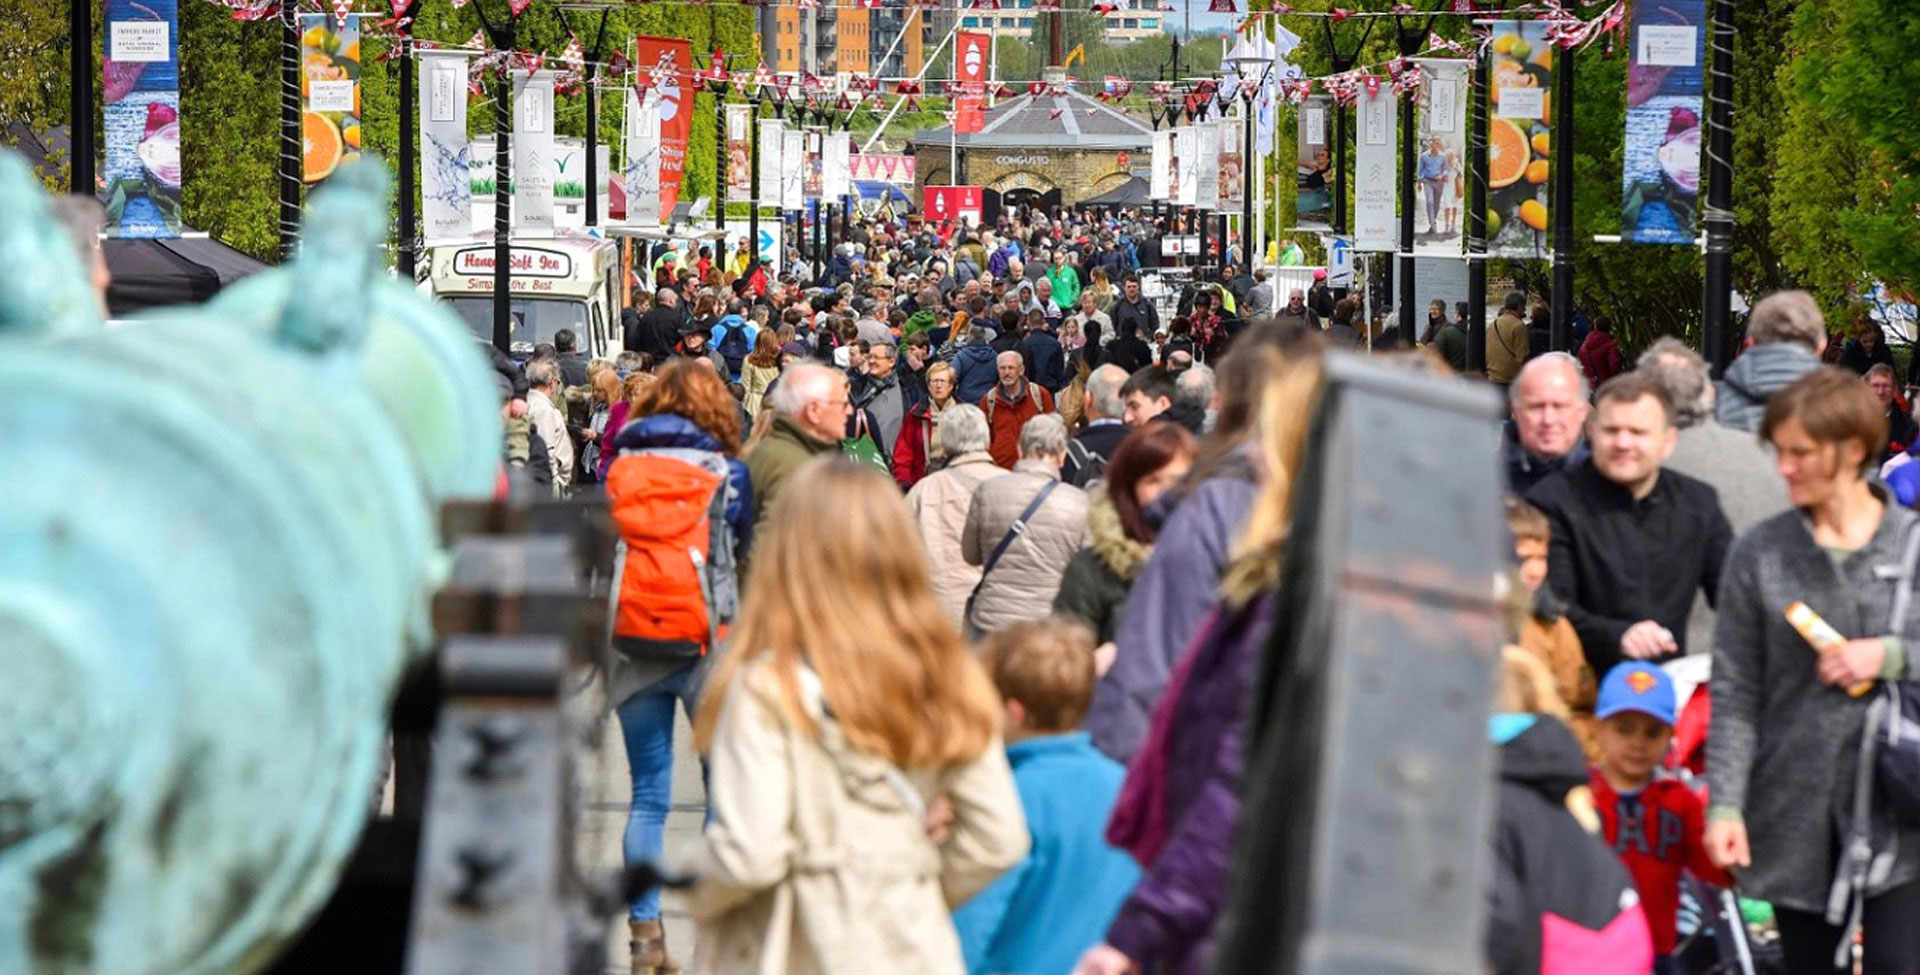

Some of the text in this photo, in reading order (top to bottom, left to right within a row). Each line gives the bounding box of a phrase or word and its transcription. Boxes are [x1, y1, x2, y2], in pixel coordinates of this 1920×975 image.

[464, 253, 496, 268] Hone
[532, 280, 552, 290] Best
[1615, 799, 1685, 862] AP
